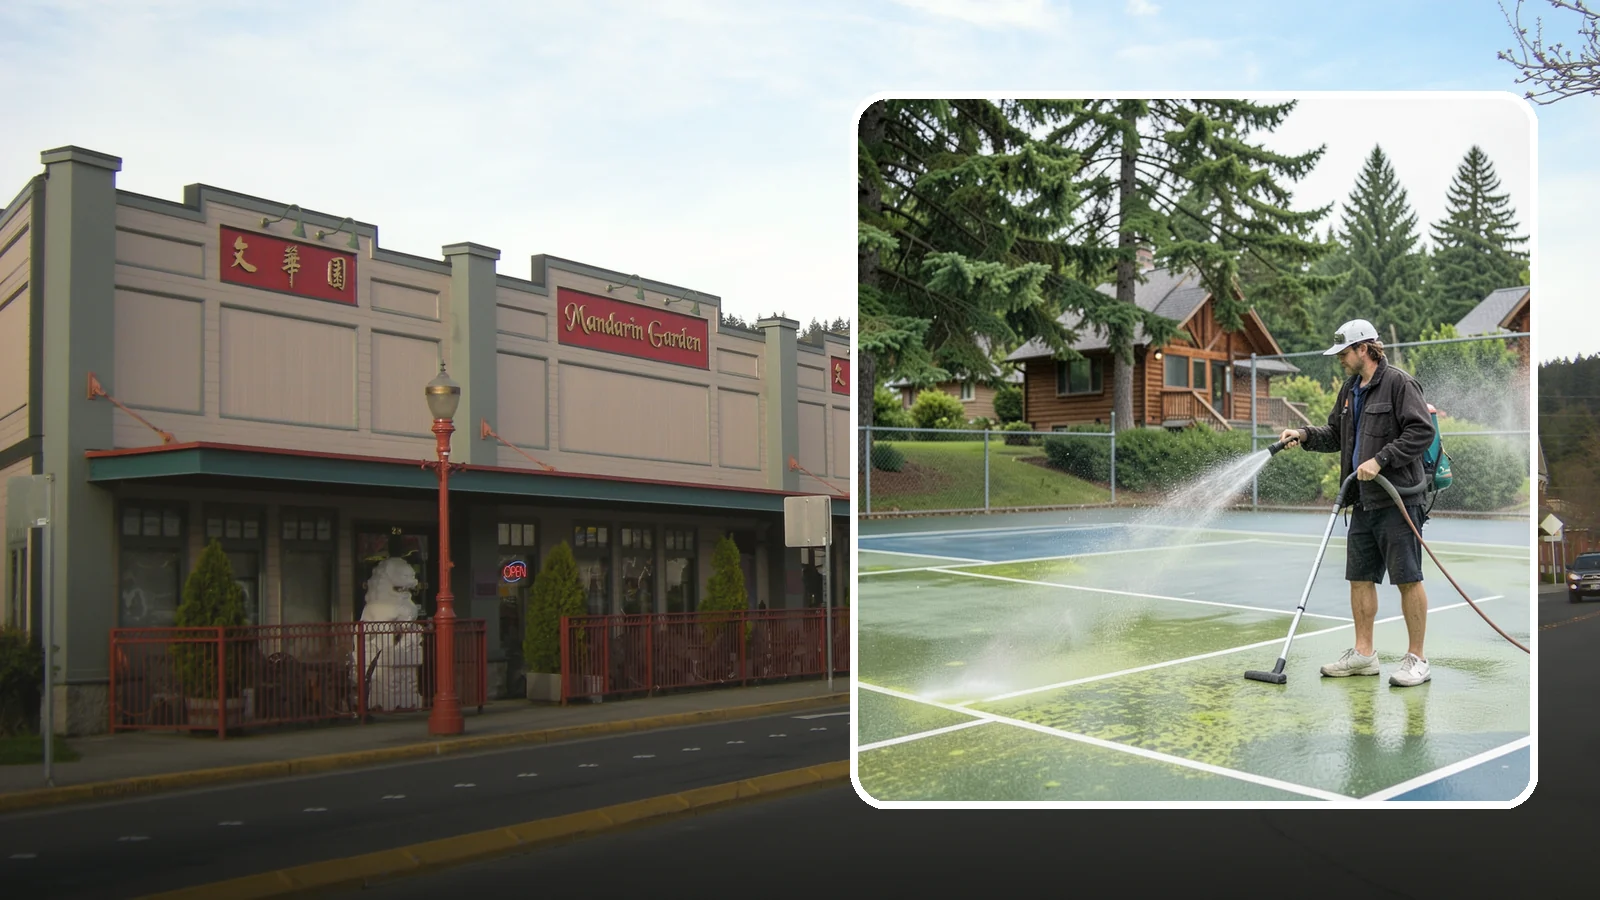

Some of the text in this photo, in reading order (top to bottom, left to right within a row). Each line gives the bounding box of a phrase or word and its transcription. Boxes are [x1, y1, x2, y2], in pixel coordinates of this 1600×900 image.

[565, 302, 701, 352] Mandarin Garden
[504, 566, 527, 578] OPEN
